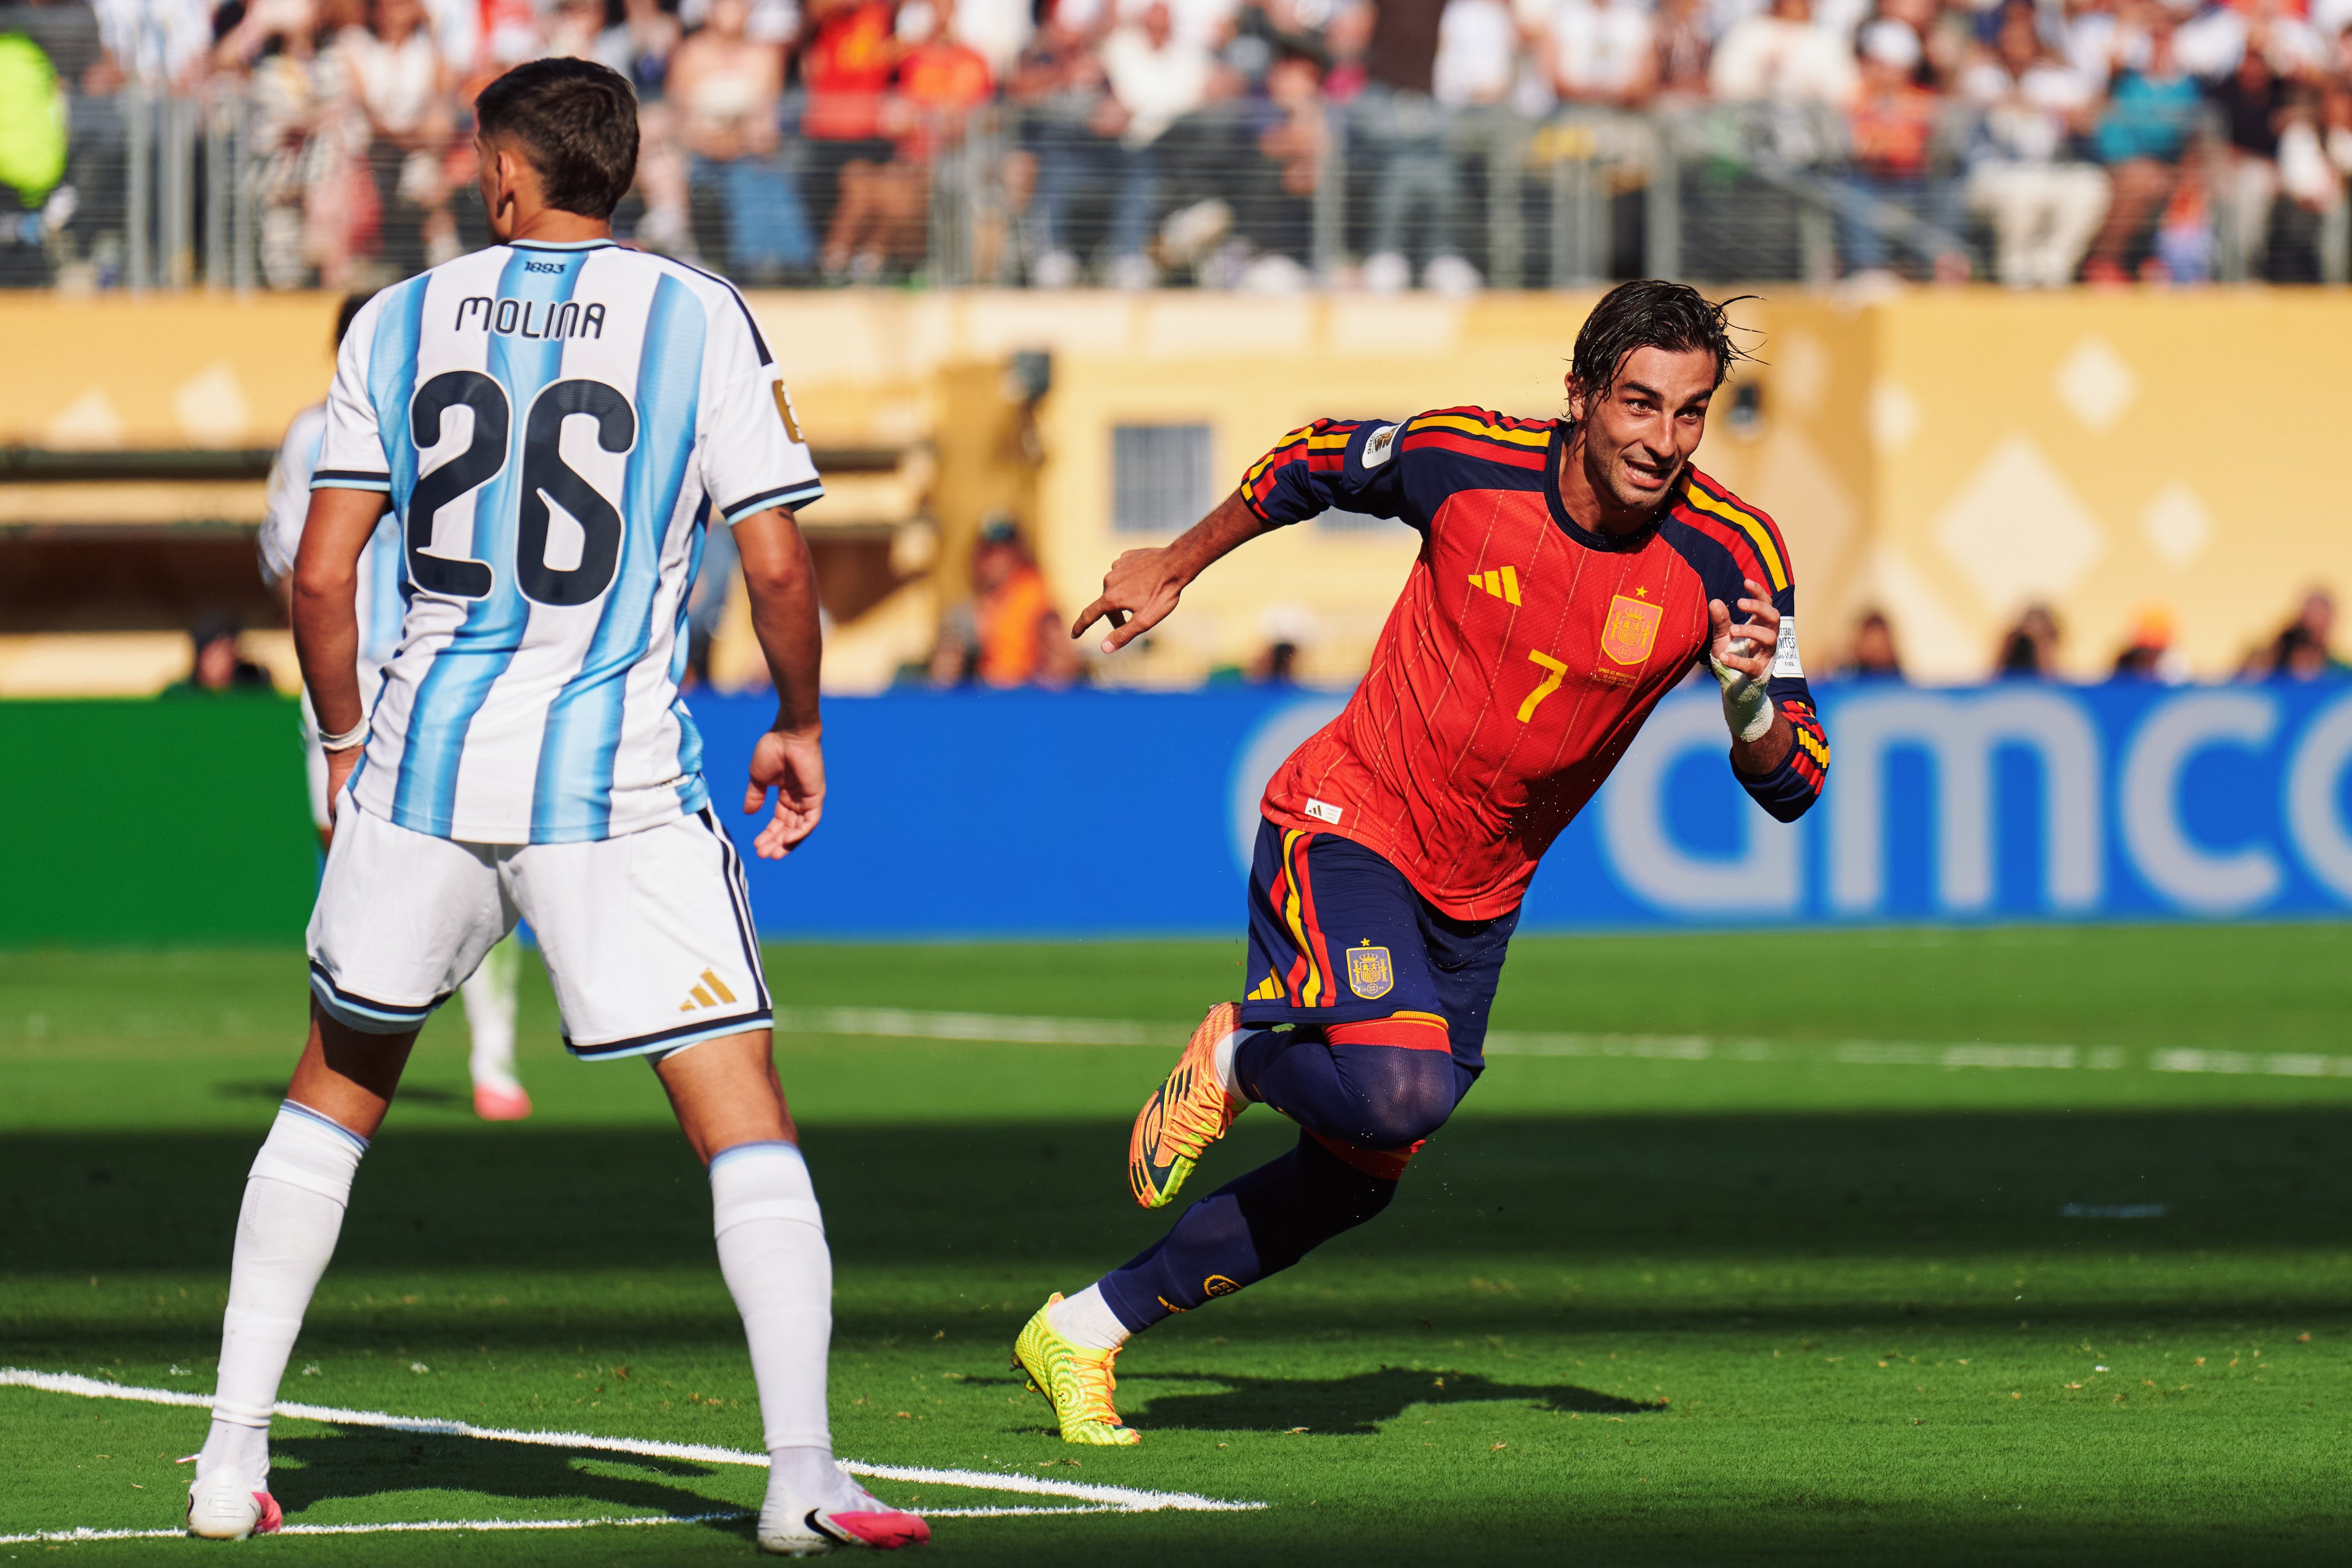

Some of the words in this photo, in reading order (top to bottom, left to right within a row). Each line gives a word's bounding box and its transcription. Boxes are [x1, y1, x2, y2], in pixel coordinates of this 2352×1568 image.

[525, 261, 565, 274] 1893
[455, 296, 606, 340] MOLINA
[407, 370, 636, 606] 26
[1779, 628, 1795, 636] OTBALL
[1779, 637, 1796, 649] NITES
[1515, 649, 1569, 724] 7
